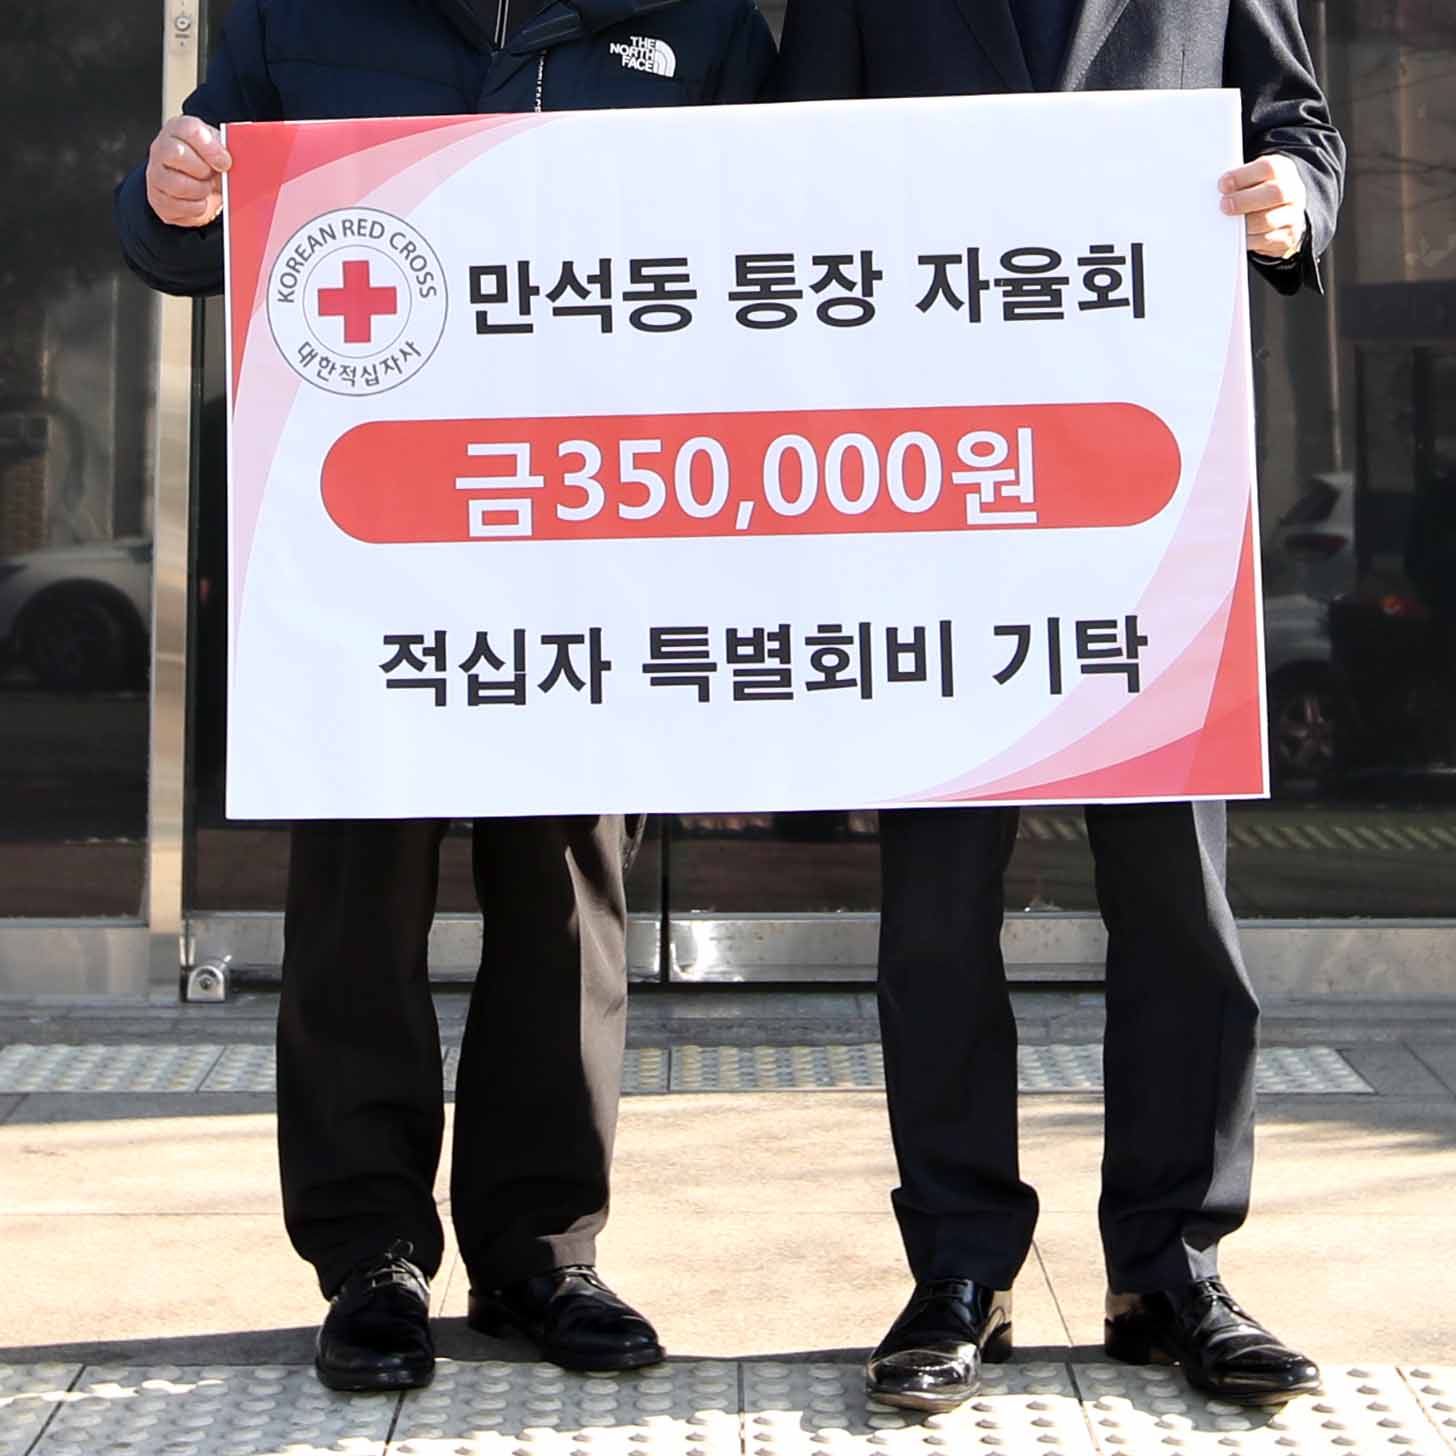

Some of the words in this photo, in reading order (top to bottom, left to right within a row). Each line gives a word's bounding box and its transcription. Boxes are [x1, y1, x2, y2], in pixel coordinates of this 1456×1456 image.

[610, 42, 655, 61] NORTH
[622, 55, 653, 73] FACE
[630, 35, 656, 49] THE
[277, 223, 337, 303] KOREAN
[341, 218, 385, 240] RED
[389, 232, 437, 298] CROSS
[467, 256, 698, 334] 만석동
[727, 249, 883, 327] 통장
[915, 241, 1148, 323] 자율회
[297, 340, 422, 387] 대한적십자사
[453, 425, 1038, 537] 금350,000원
[378, 627, 611, 707] 적십자
[641, 620, 954, 704] 특별회비
[992, 614, 1149, 694] 기탁
